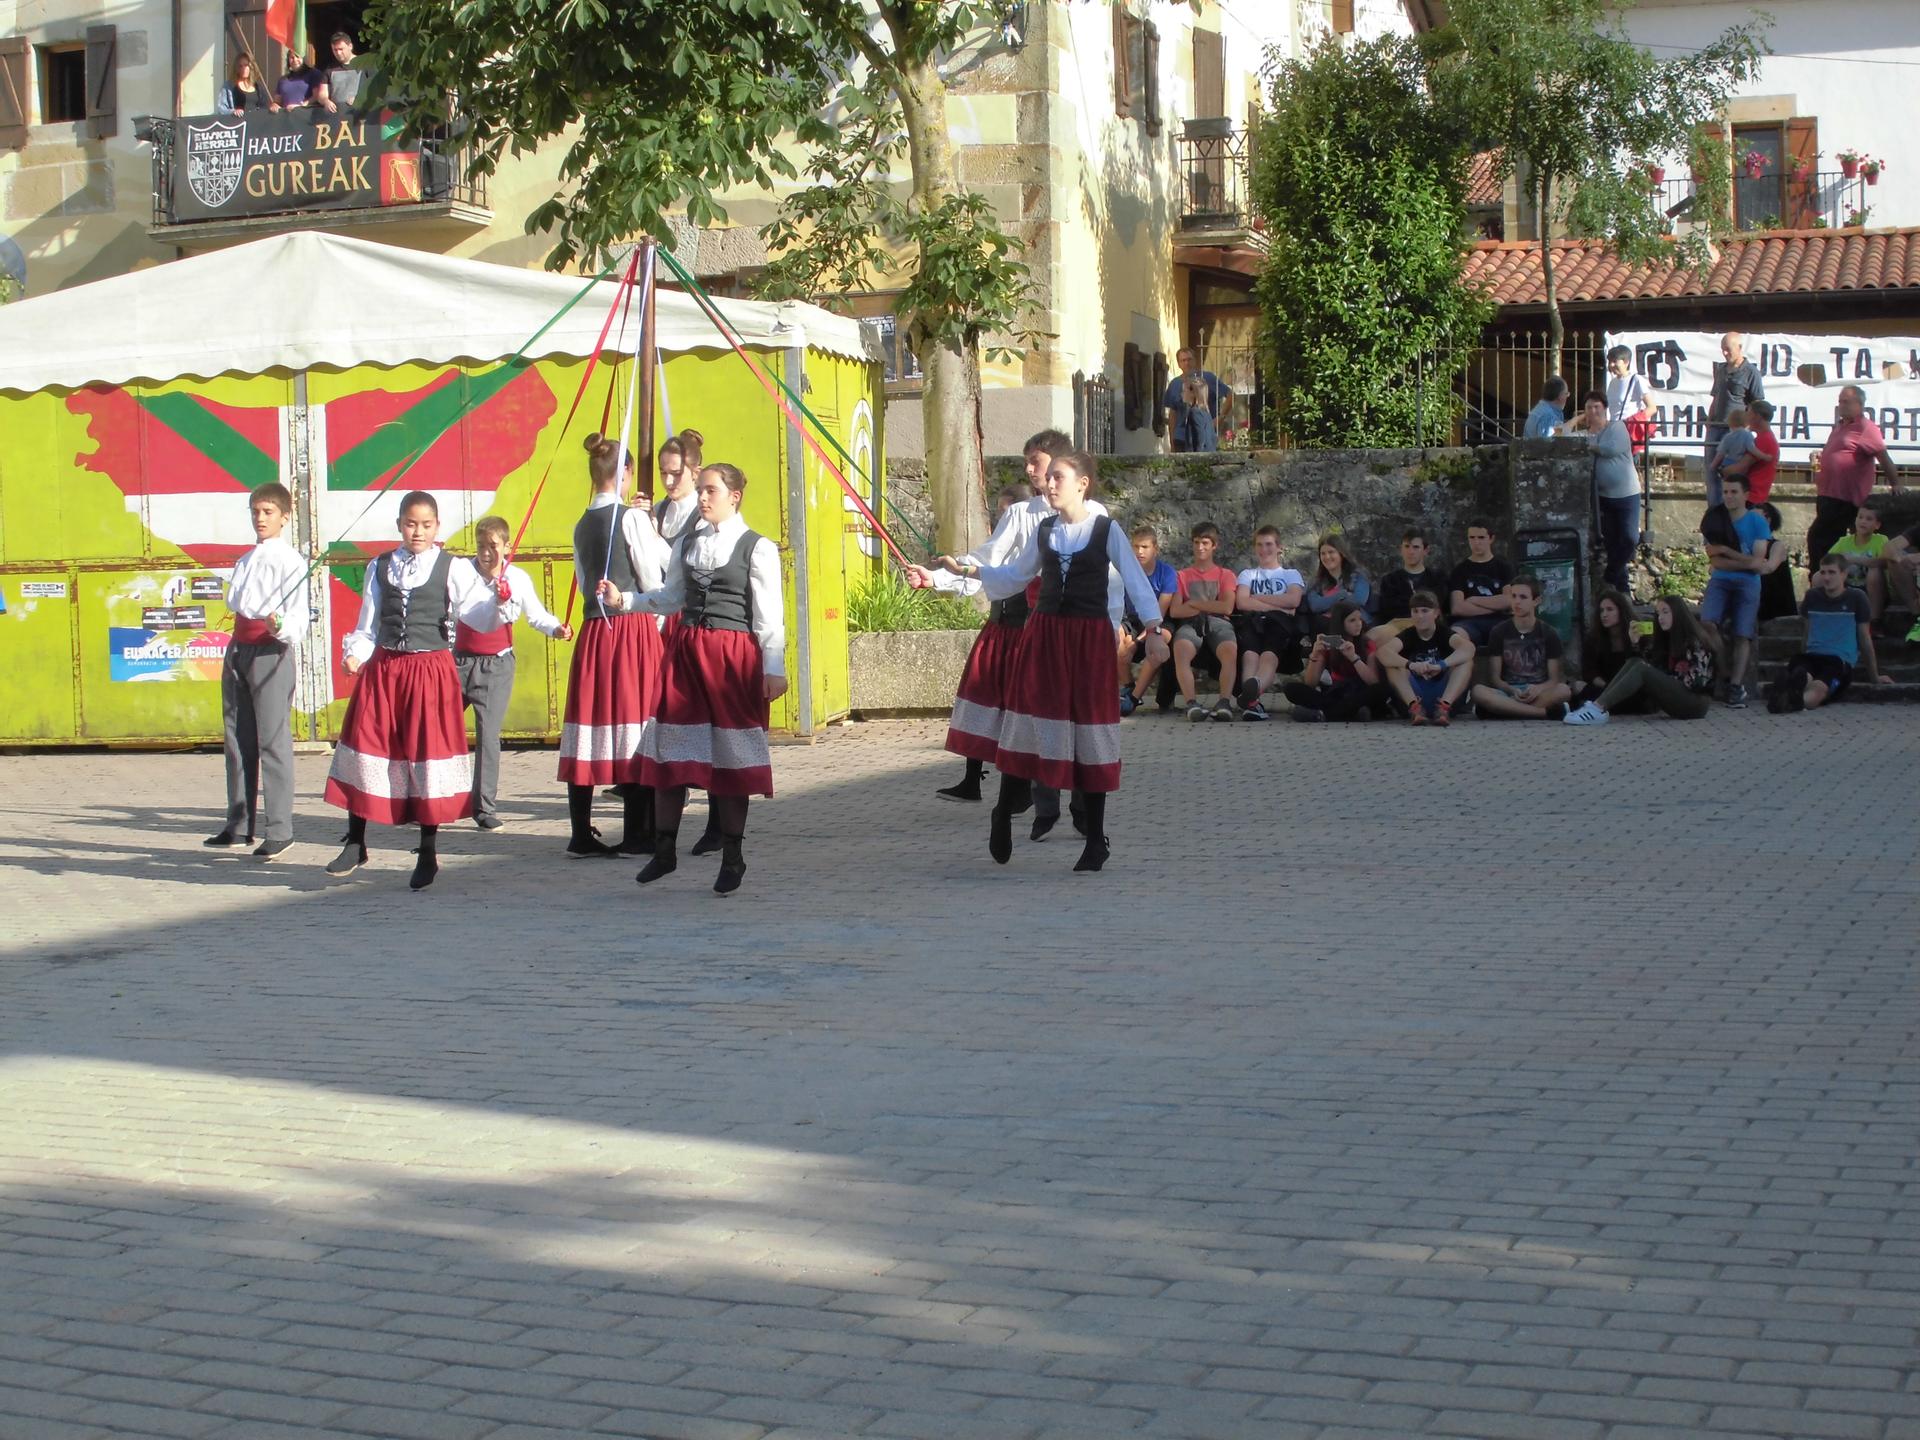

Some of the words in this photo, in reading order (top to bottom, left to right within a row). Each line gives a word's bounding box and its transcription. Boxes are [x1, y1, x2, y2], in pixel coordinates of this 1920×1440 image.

[194, 130, 239, 142] EUSKAL
[247, 134, 303, 156] HAUEK
[315, 119, 367, 150] BAI
[245, 155, 372, 198] GUREAK
[1830, 347, 1874, 379] TA
